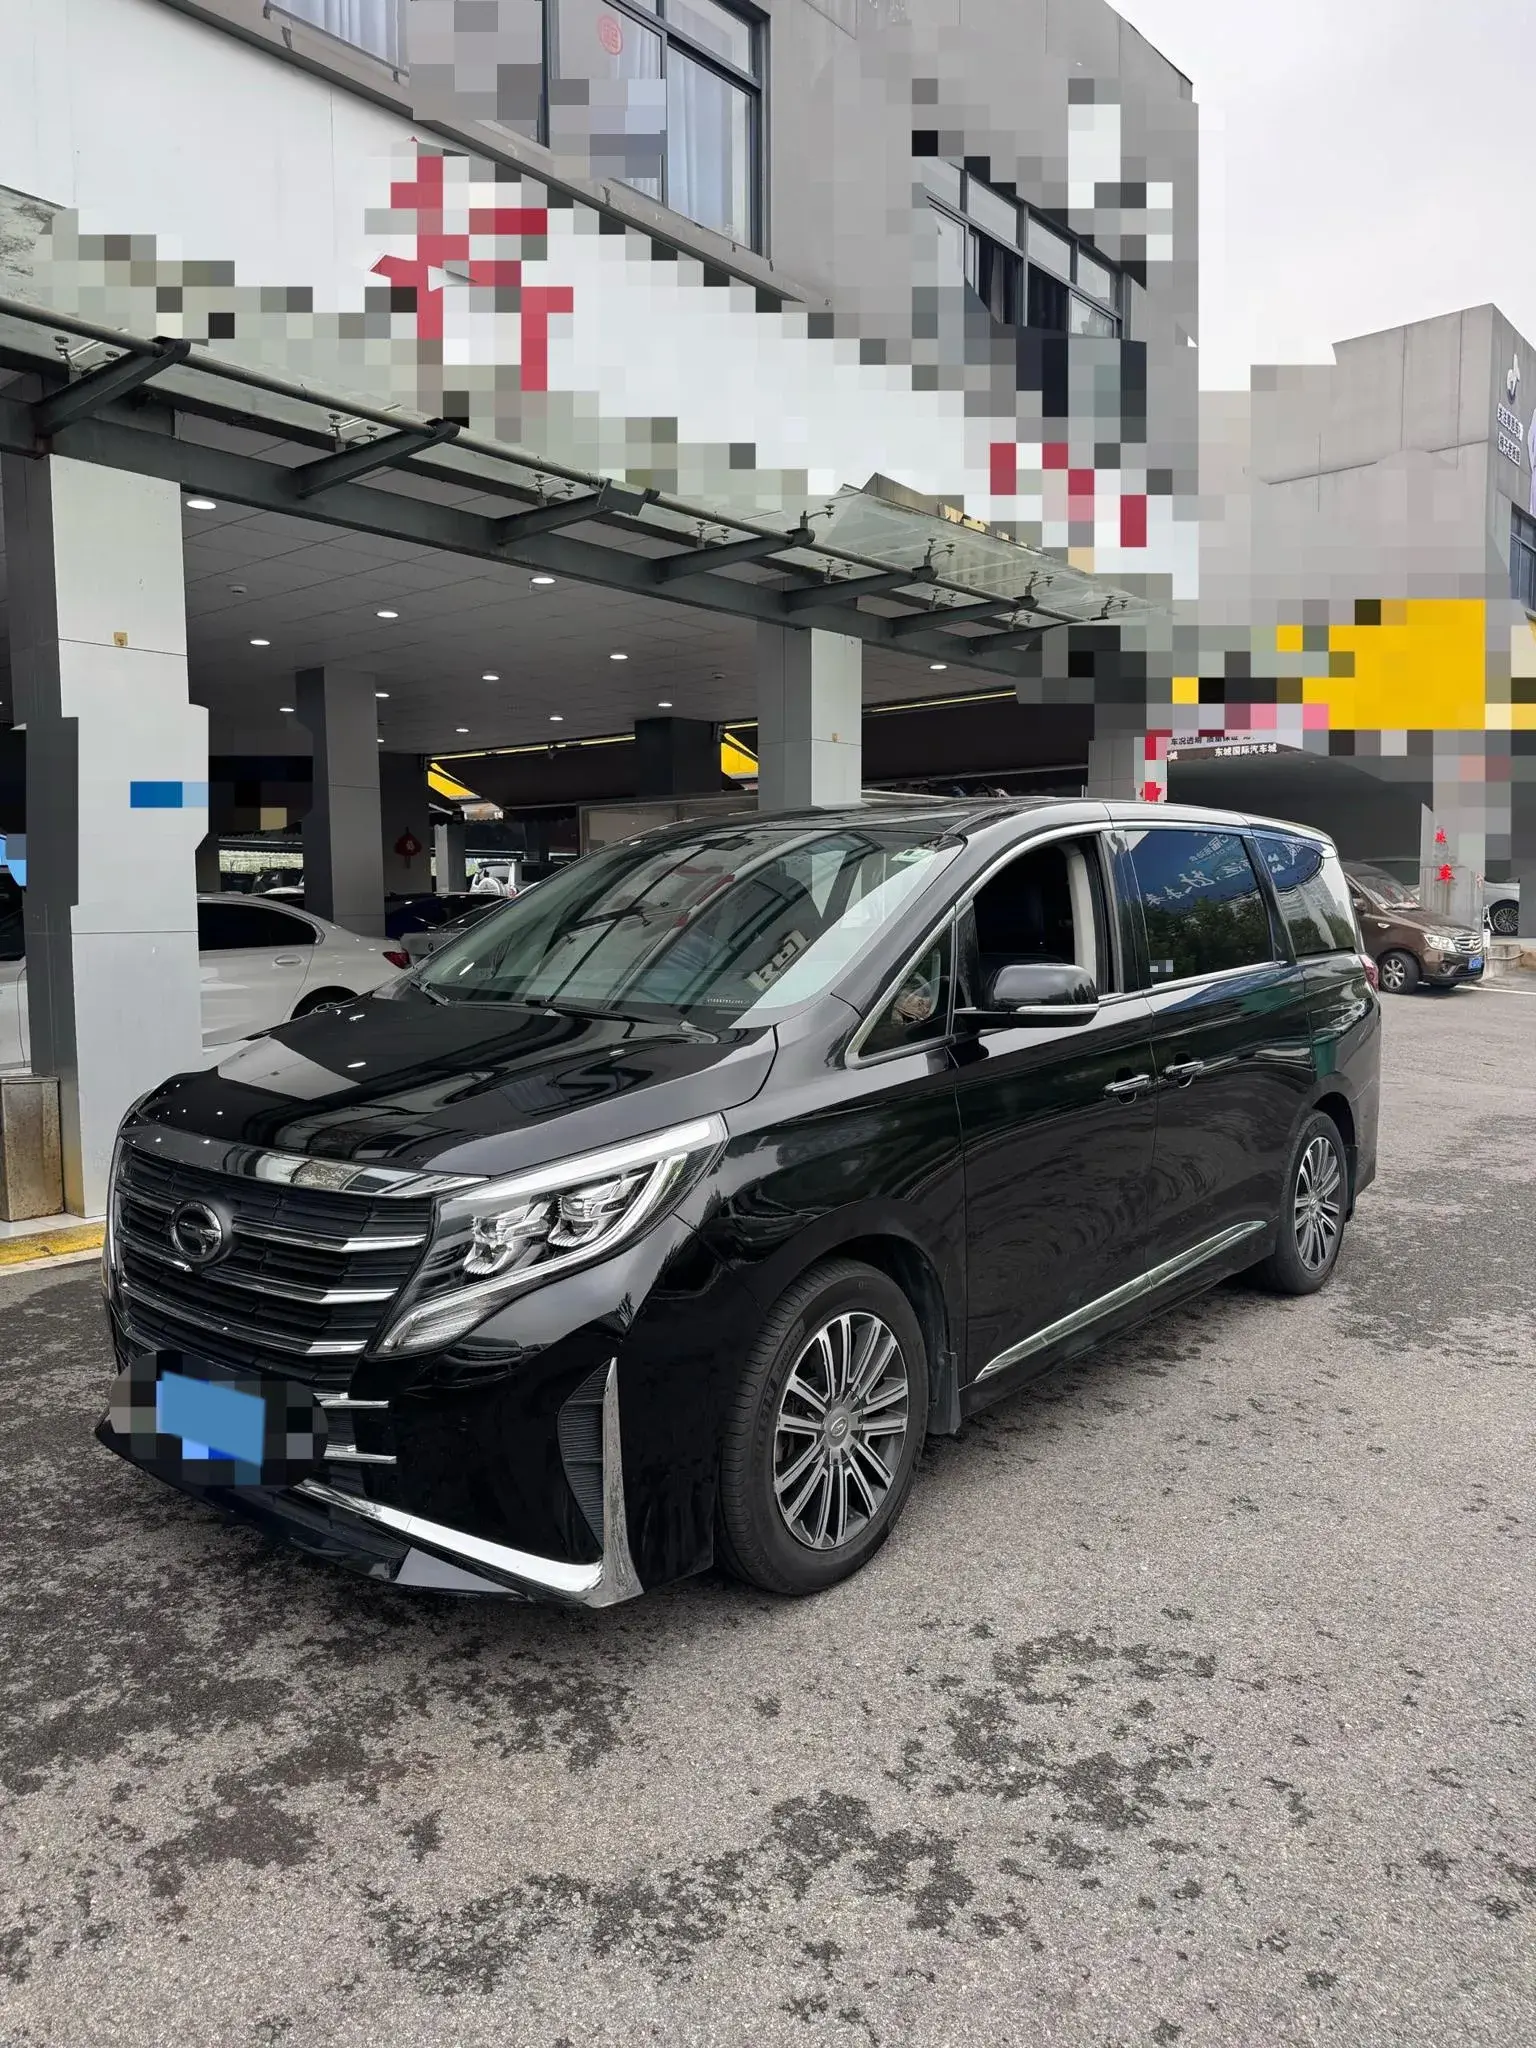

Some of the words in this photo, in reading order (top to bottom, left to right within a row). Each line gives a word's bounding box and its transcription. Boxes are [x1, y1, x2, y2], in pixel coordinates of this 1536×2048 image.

[1215, 743, 1277, 756] 东城国际汽车城
